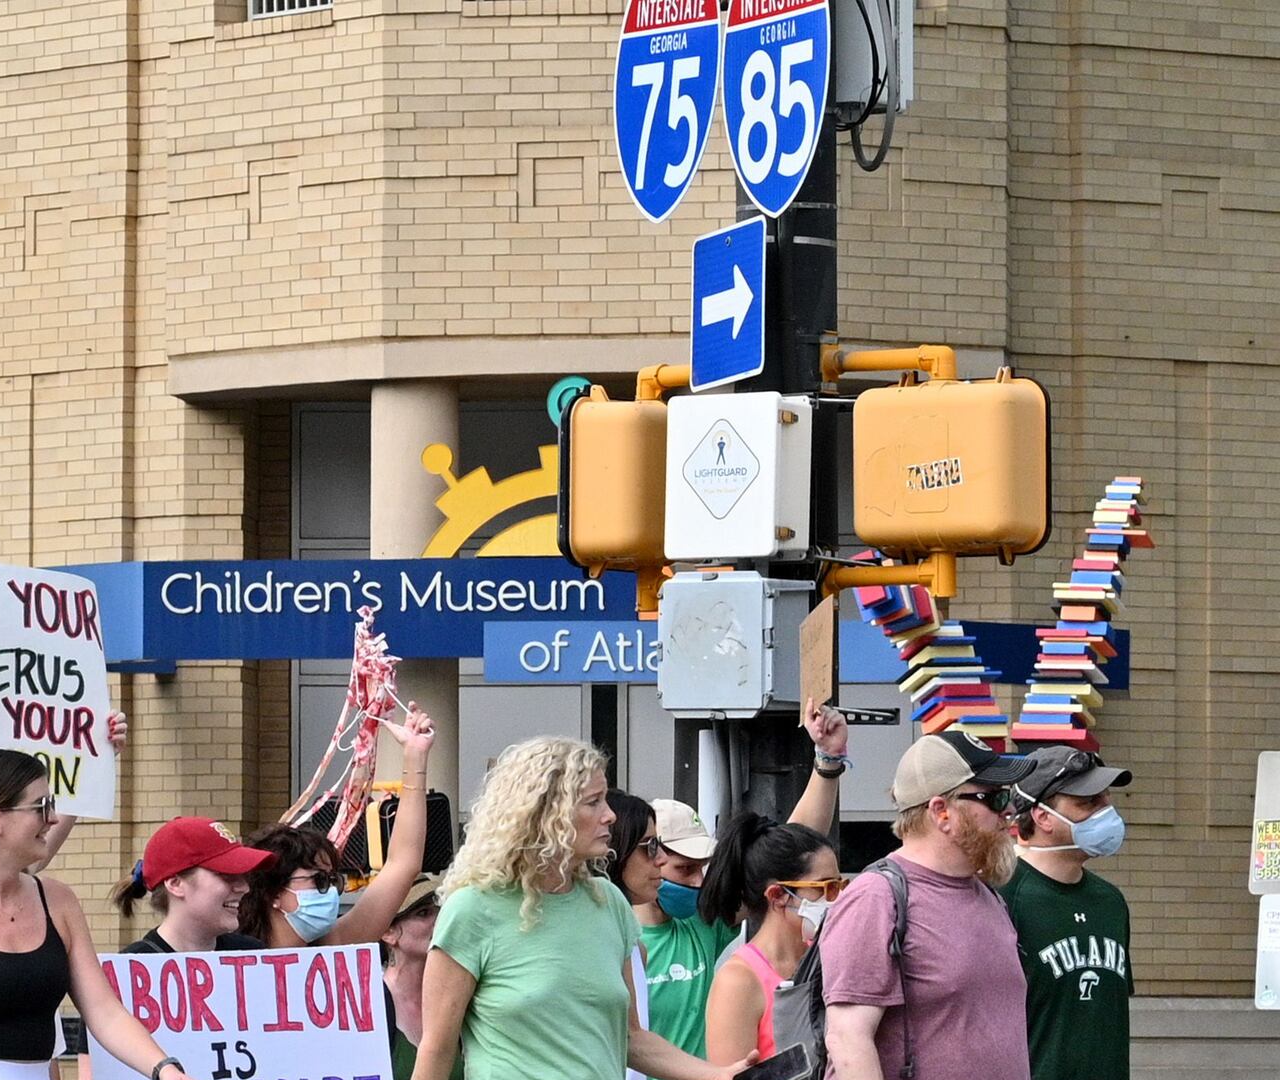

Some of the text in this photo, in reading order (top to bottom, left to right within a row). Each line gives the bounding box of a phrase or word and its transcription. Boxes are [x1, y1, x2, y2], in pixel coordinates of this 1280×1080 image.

[650, 32, 688, 54] GEORGIA
[760, 20, 796, 45] GEORGIA
[632, 56, 701, 190] 75
[738, 38, 815, 185] 85
[694, 466, 748, 478] LIGHTGUARD
[400, 571, 606, 612] Museum
[8, 579, 102, 650] YOUR
[519, 630, 658, 673] of Atla
[2, 697, 98, 757] YOUR
[1038, 935, 1126, 979] TULANE
[101, 948, 374, 1034] ABORTION
[211, 1040, 257, 1080] IS
